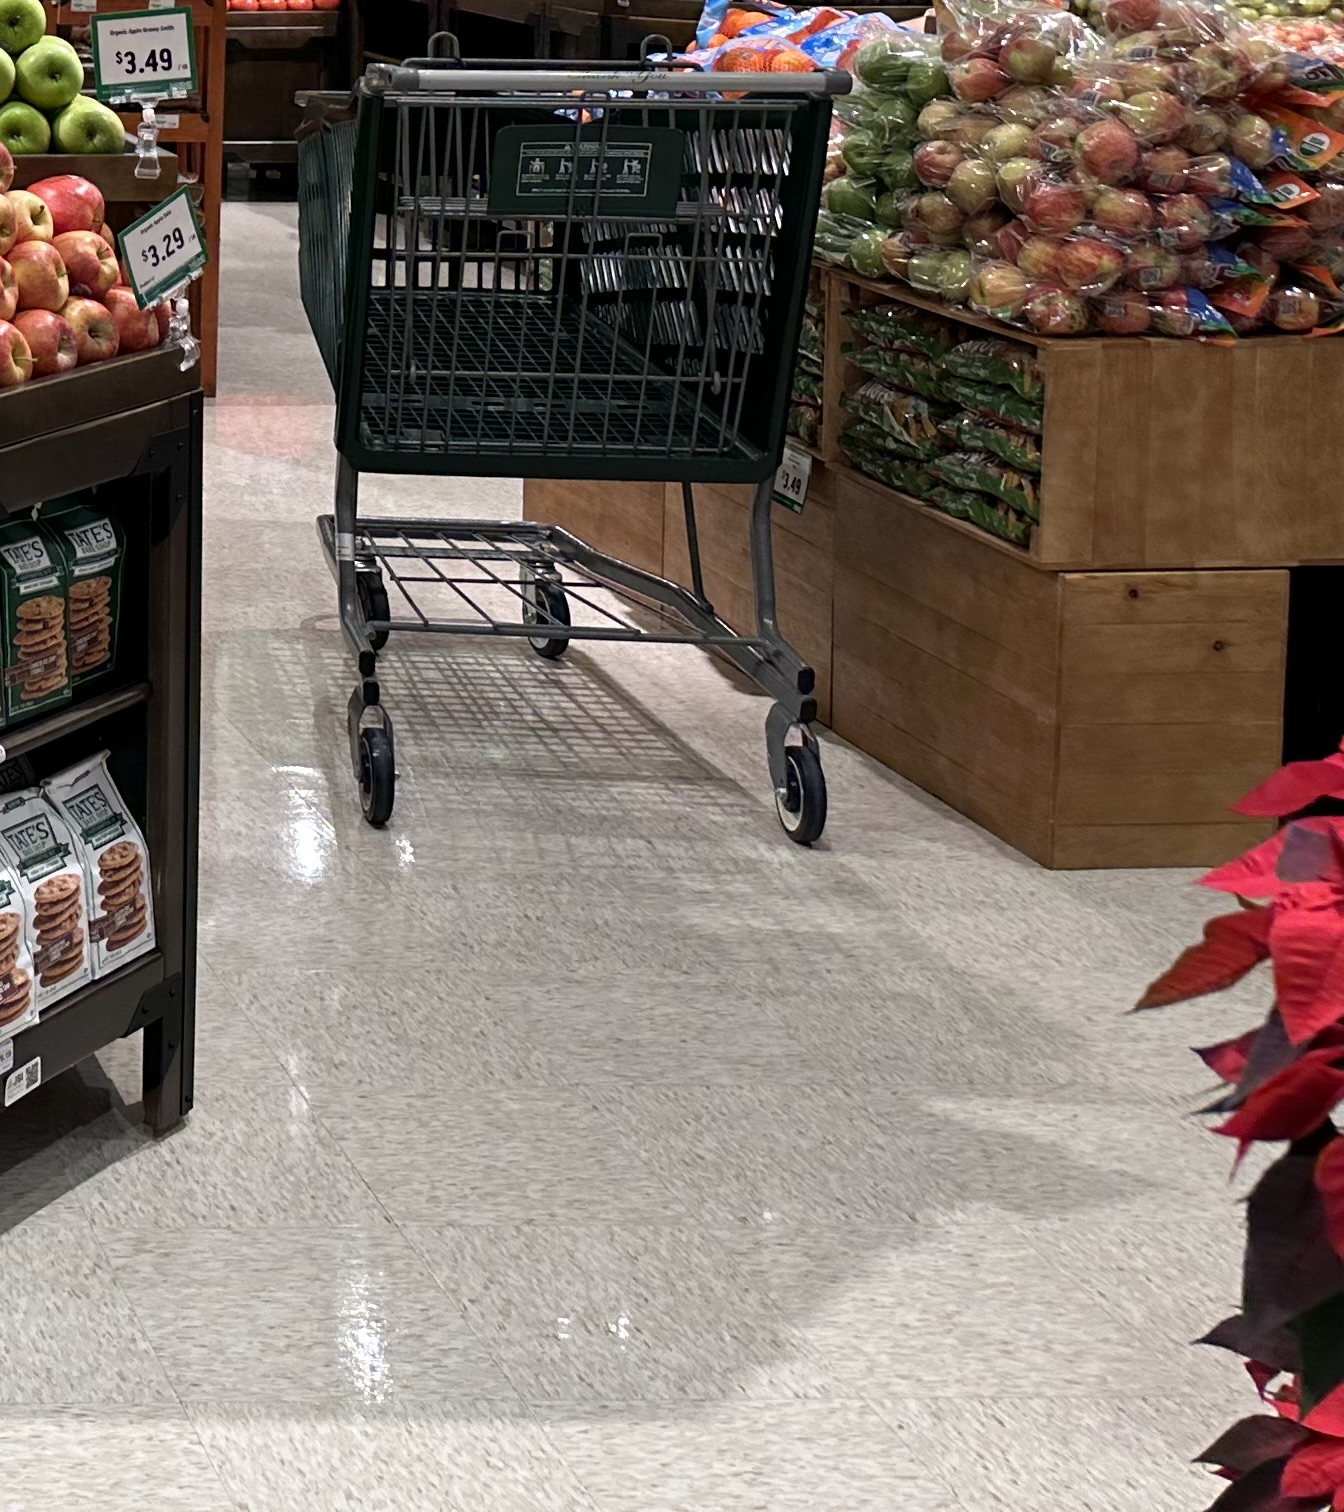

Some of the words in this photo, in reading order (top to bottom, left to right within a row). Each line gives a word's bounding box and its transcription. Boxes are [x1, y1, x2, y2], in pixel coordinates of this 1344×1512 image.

[116, 48, 172, 74] $3.49
[141, 227, 184, 267] $3.29
[69, 791, 107, 820] TATE'S
[7, 820, 49, 851] TATE'S
